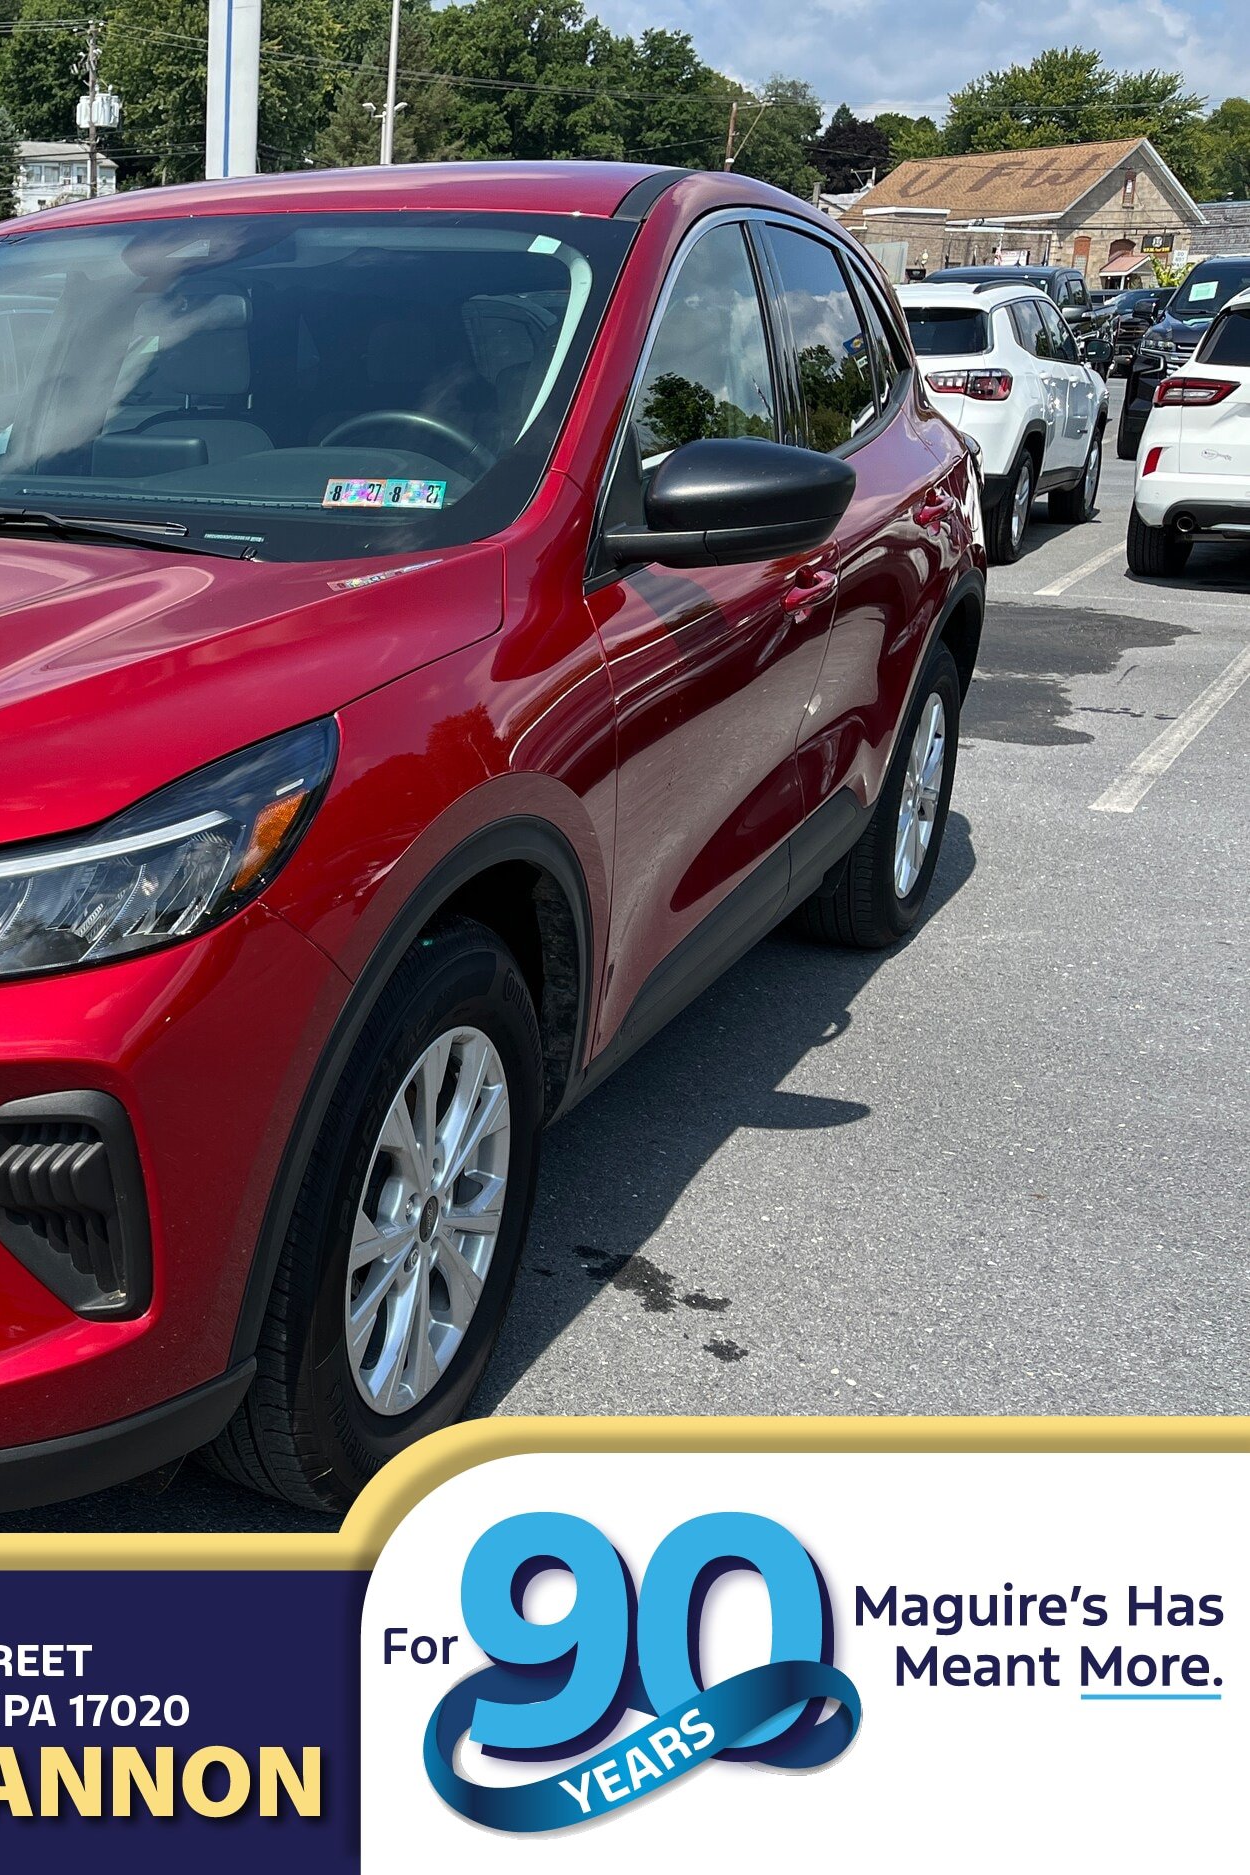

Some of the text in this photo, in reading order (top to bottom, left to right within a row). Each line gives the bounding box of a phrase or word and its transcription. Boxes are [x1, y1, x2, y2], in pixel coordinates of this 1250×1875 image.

[332, 483, 382, 502] 8 27
[391, 485, 442, 503] 8 27
